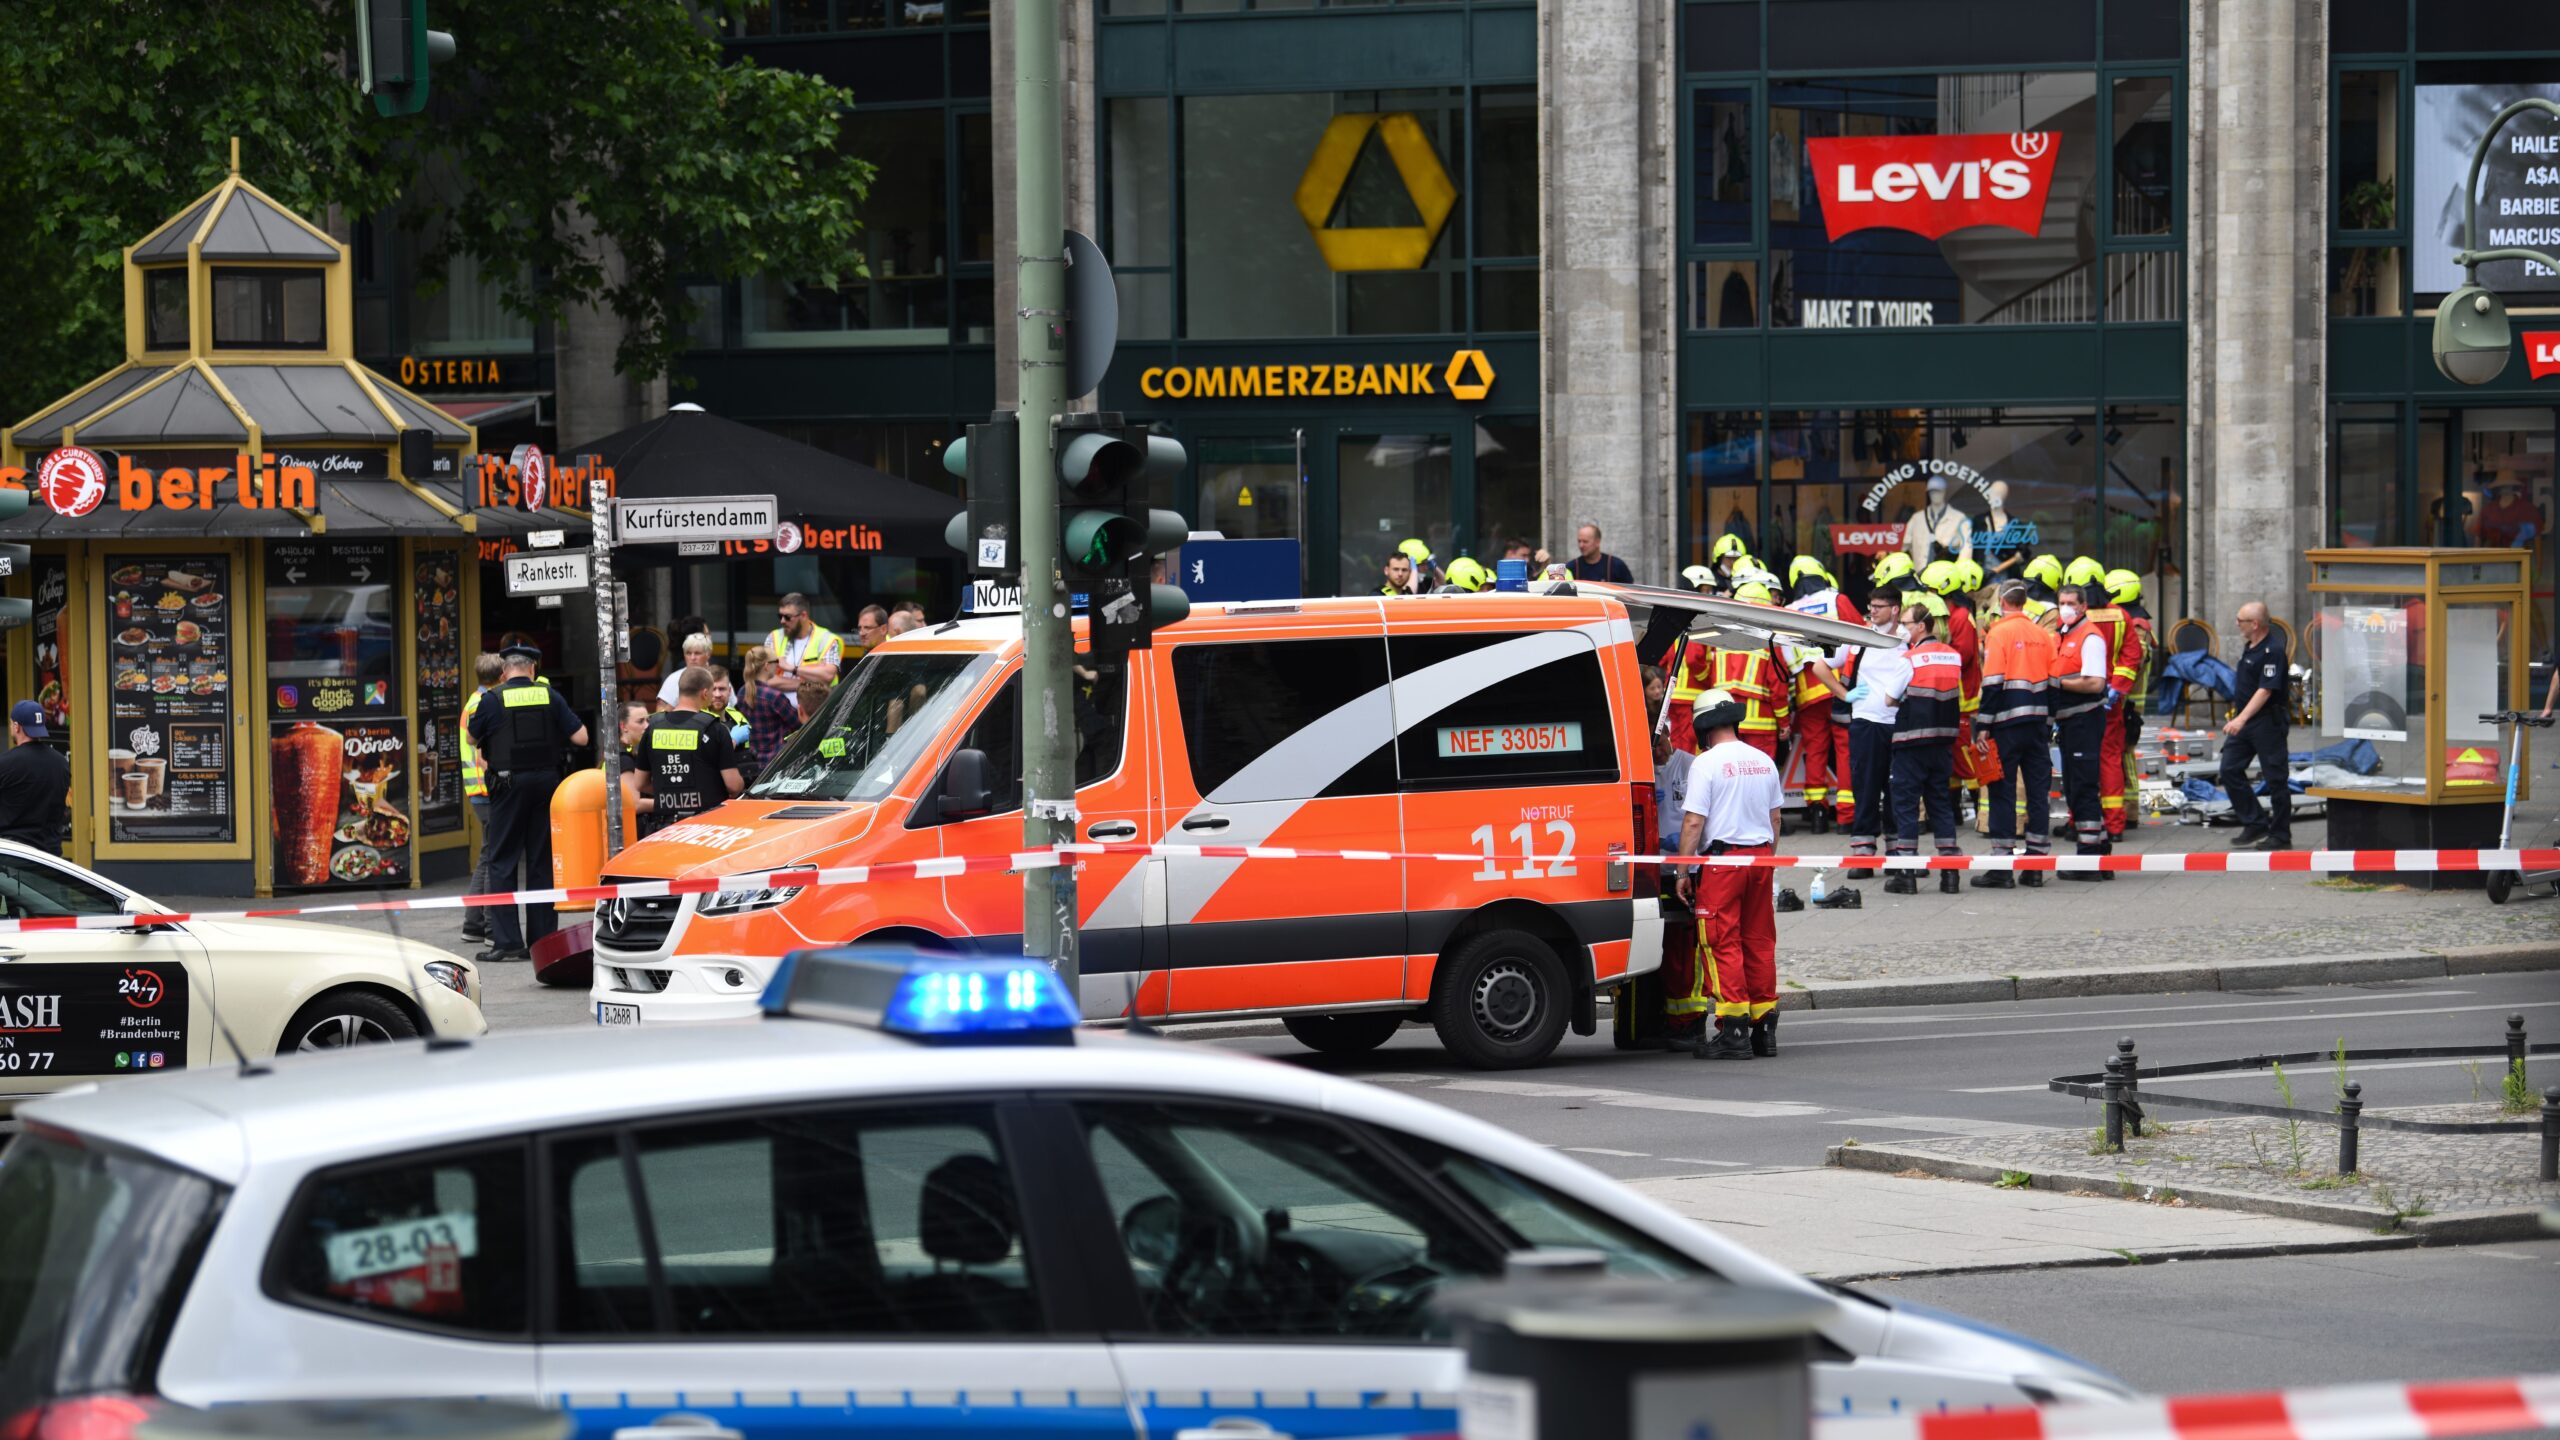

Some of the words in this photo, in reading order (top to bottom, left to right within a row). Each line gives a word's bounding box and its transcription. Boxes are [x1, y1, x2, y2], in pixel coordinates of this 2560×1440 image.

[2512, 136, 2560, 154] HAILE
[2525, 167, 2560, 187] A$A
[2500, 198, 2560, 216] BARBIE
[1803, 300, 1852, 328] MAKE
[1858, 301, 1874, 328] IT
[1878, 301, 1934, 328] YOURS
[401, 355, 500, 386] OSTERIA
[1140, 363, 1434, 398] COMMERZBANK
[61, 448, 104, 482] CURRYWURST
[322, 456, 364, 474] Kebap
[118, 453, 316, 512] berlin
[1862, 463, 1915, 513] RIDING
[1919, 459, 2001, 510] TOGETHER
[625, 507, 768, 530] Kurfürstendamm
[803, 522, 883, 551] berlin
[521, 561, 577, 582] Rankestr.
[977, 585, 1022, 607] NOTA
[312, 696, 354, 709] Google
[320, 688, 343, 700] find
[345, 736, 404, 757] Döner
[654, 732, 697, 748] POLIZEI
[1450, 729, 1494, 754] NEF
[1501, 726, 1567, 751] 3305/1
[668, 754, 681, 764] BE
[661, 764, 690, 775] 32320
[659, 792, 702, 809] POLIZEI
[1520, 805, 1575, 821] NOTRUF
[1471, 820, 1577, 882] 112
[120, 1016, 162, 1027] #Berlin
[100, 1029, 181, 1040] #Brandenburg
[28, 1052, 55, 1070] 77
